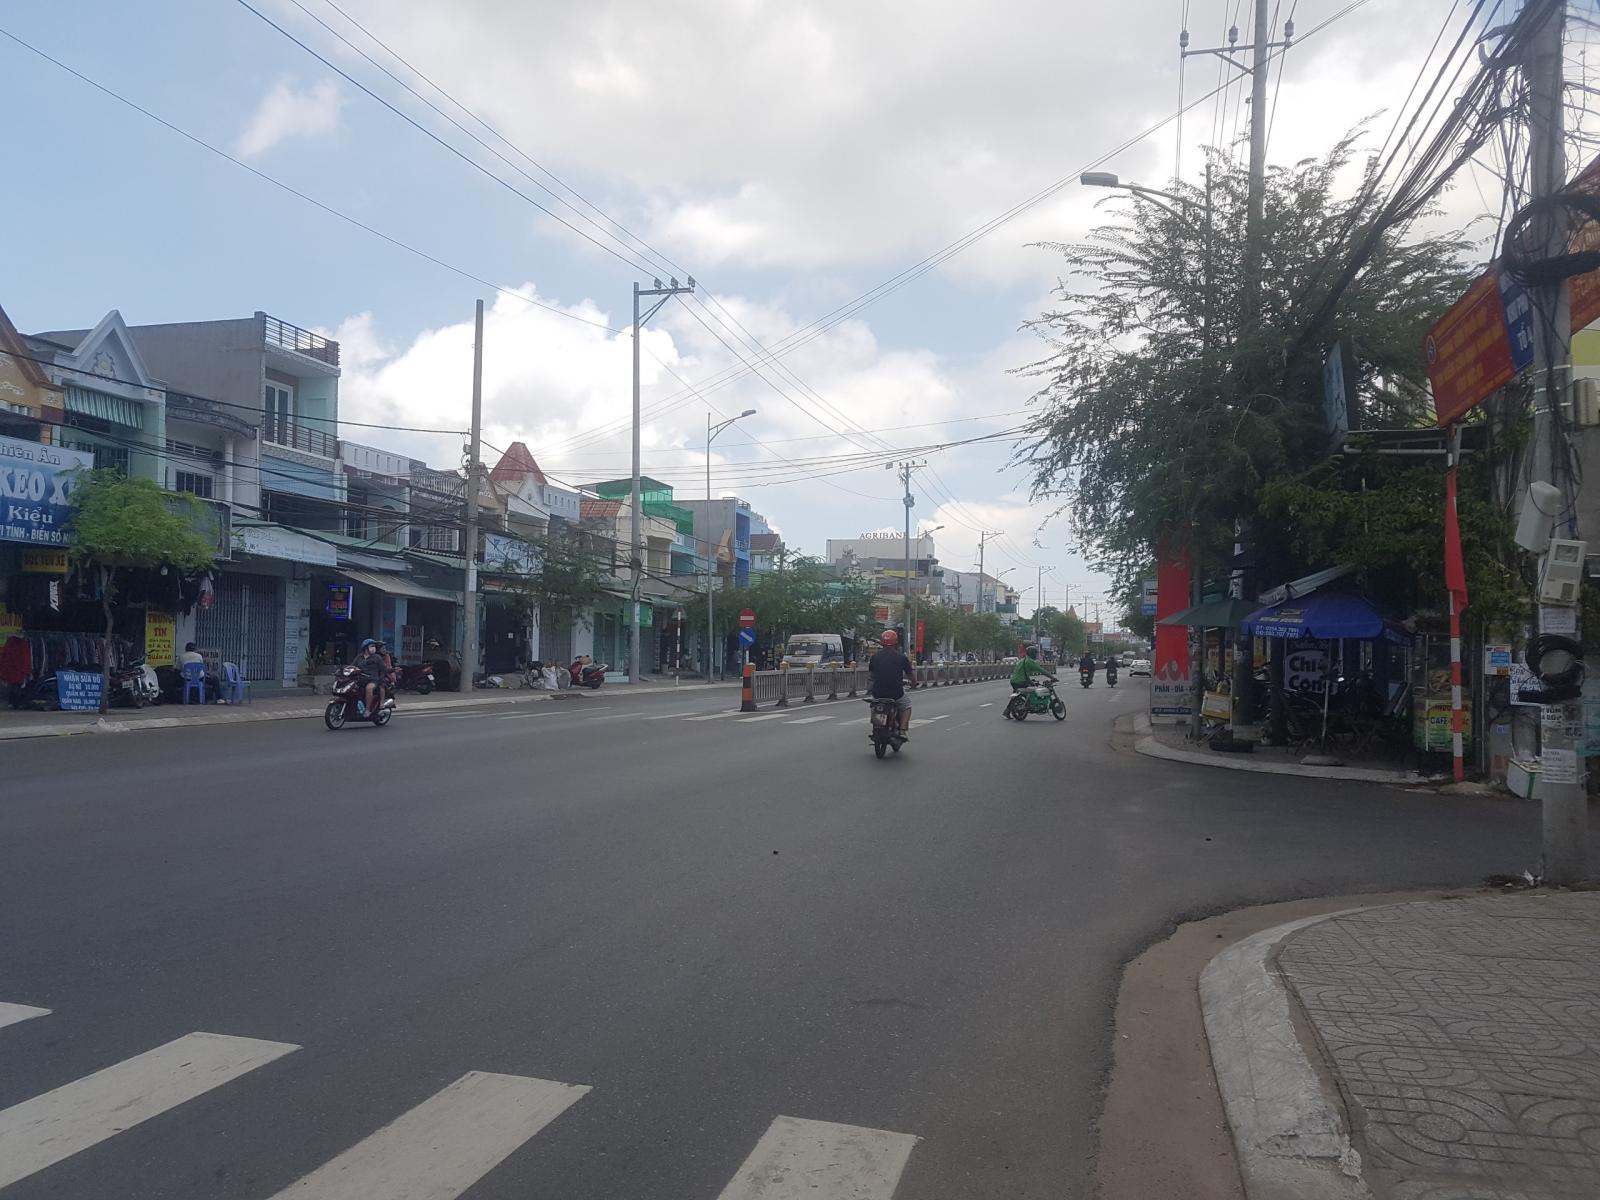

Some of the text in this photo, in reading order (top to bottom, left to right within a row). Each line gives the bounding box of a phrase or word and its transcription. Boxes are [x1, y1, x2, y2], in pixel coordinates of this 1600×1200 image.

[9, 505, 53, 524] Kiểu
[6, 523, 26, 539] TÍNH
[31, 524, 50, 543] BIỂN
